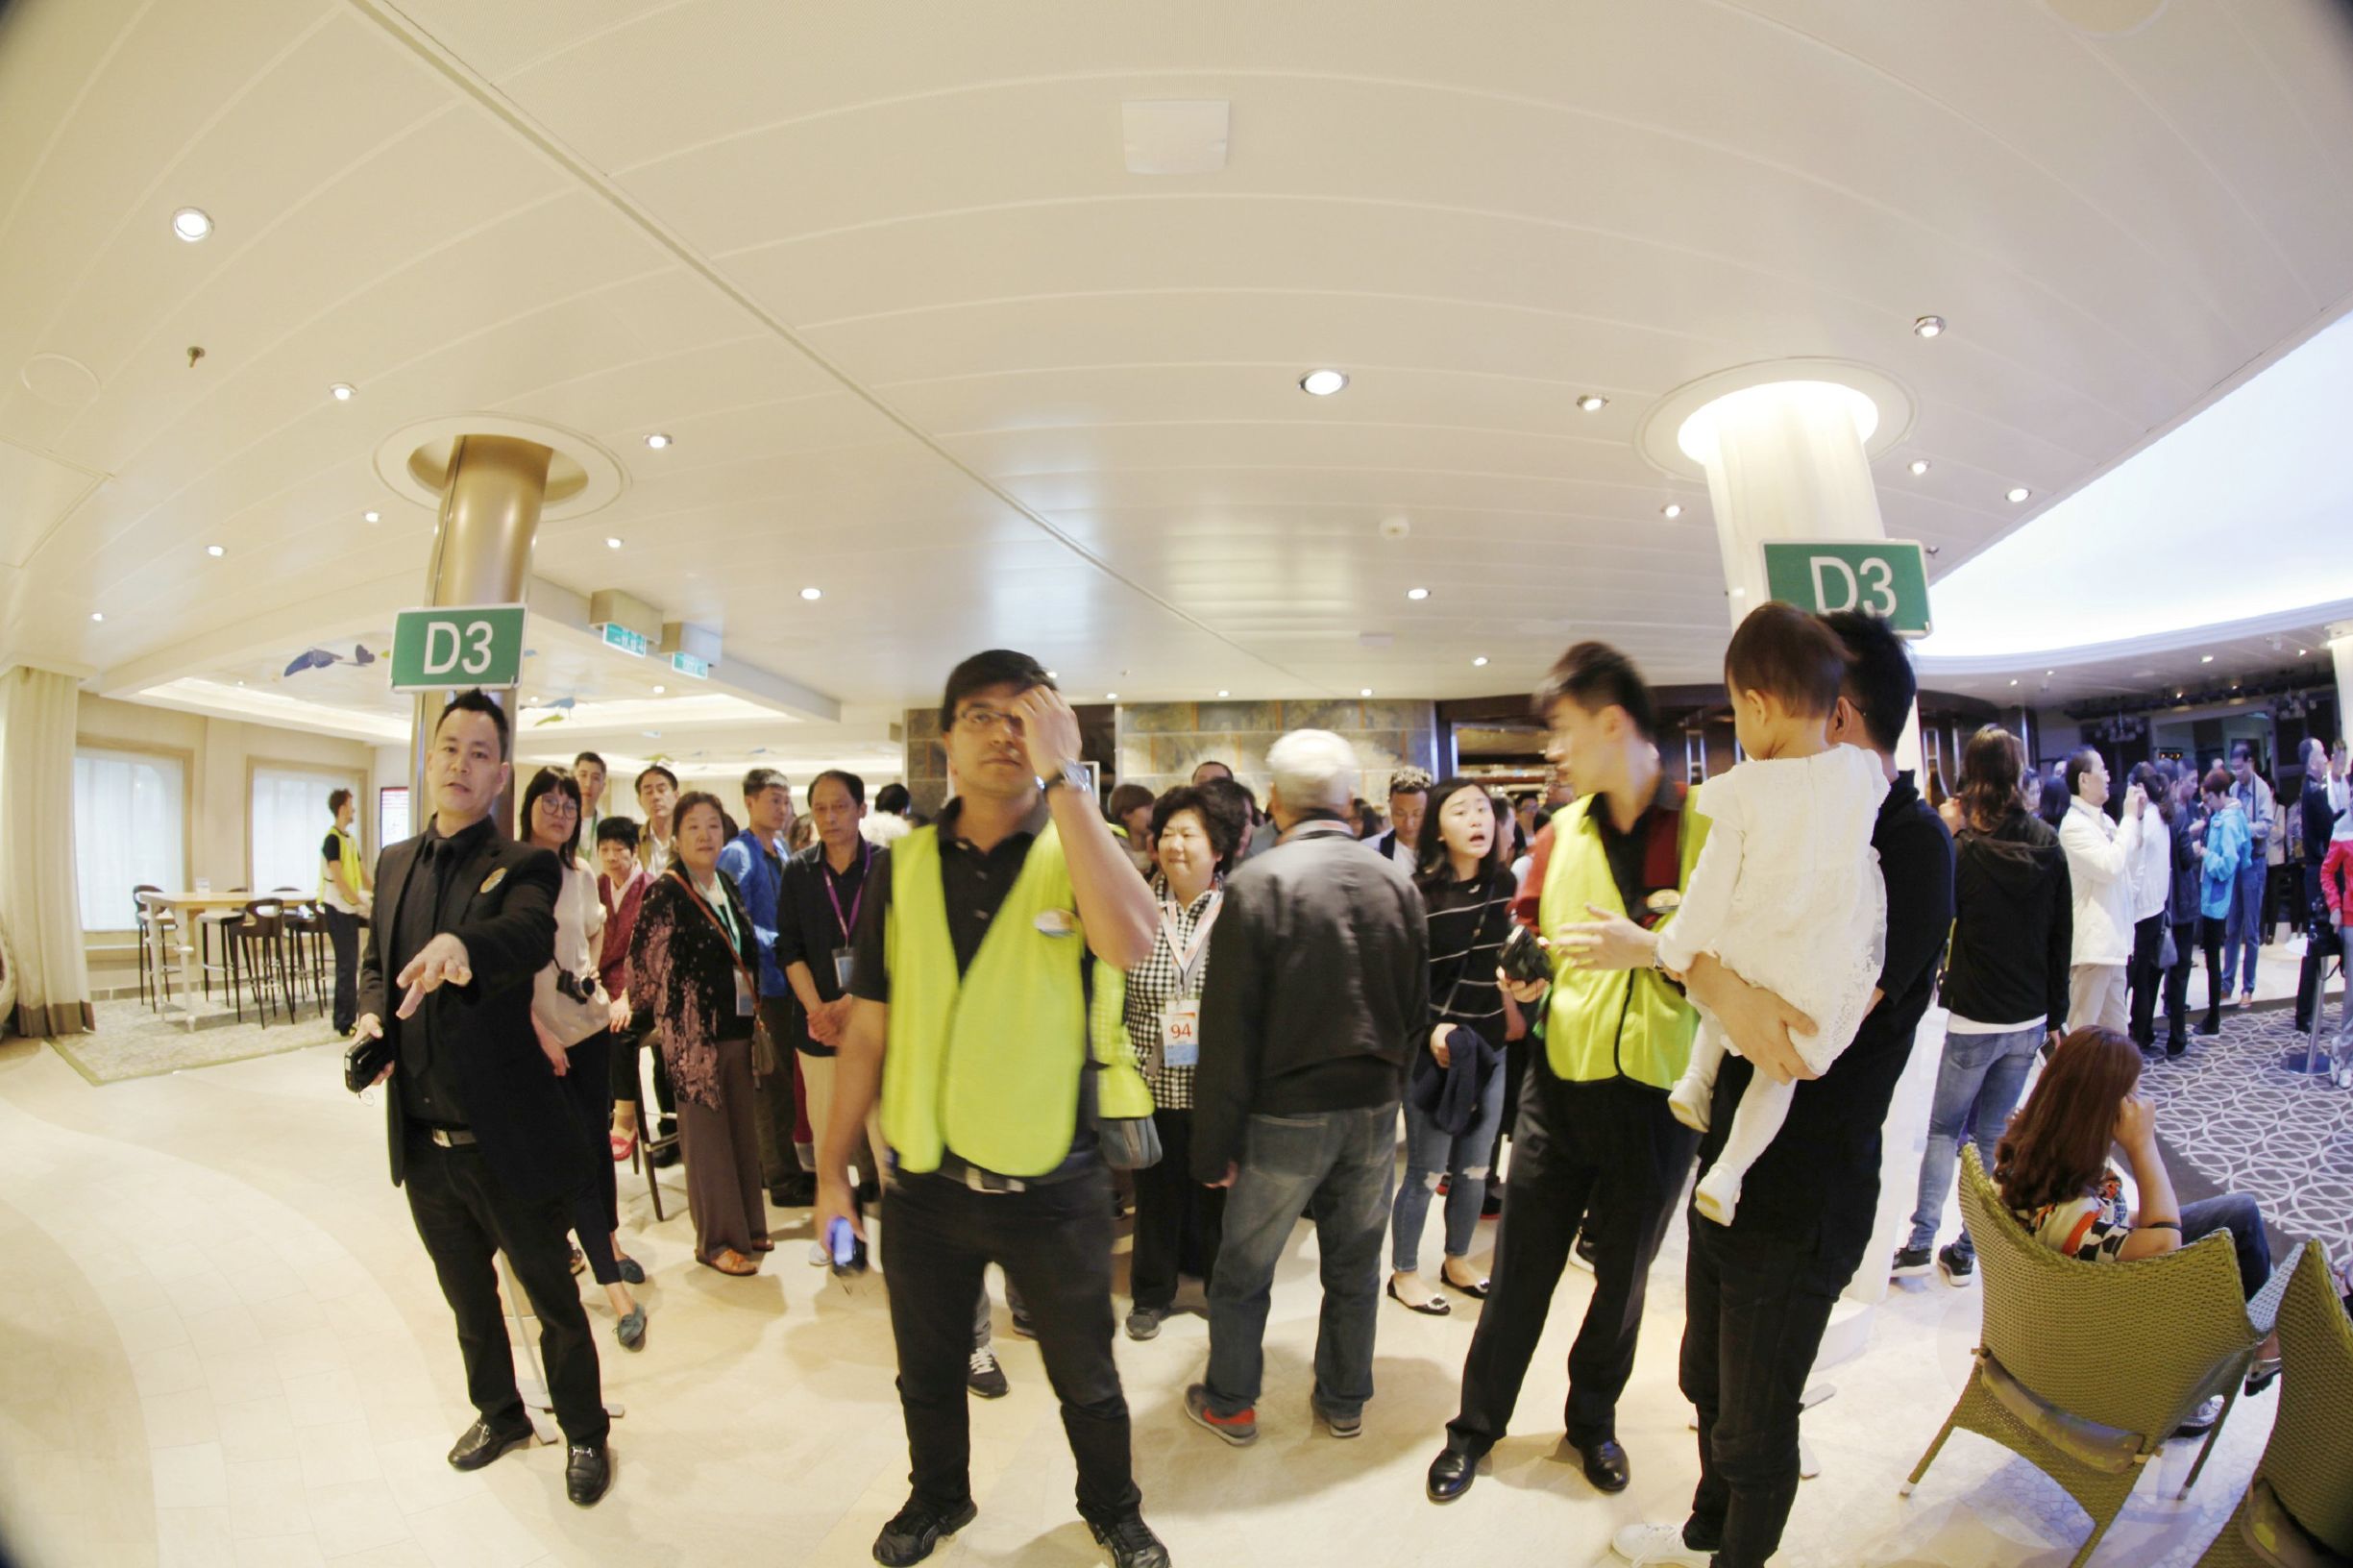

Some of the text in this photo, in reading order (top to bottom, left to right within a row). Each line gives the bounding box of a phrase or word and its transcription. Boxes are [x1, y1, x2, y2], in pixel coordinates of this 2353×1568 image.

[1809, 556, 1898, 618] D3
[424, 621, 493, 674] D3
[1171, 1024, 1191, 1039] 94
